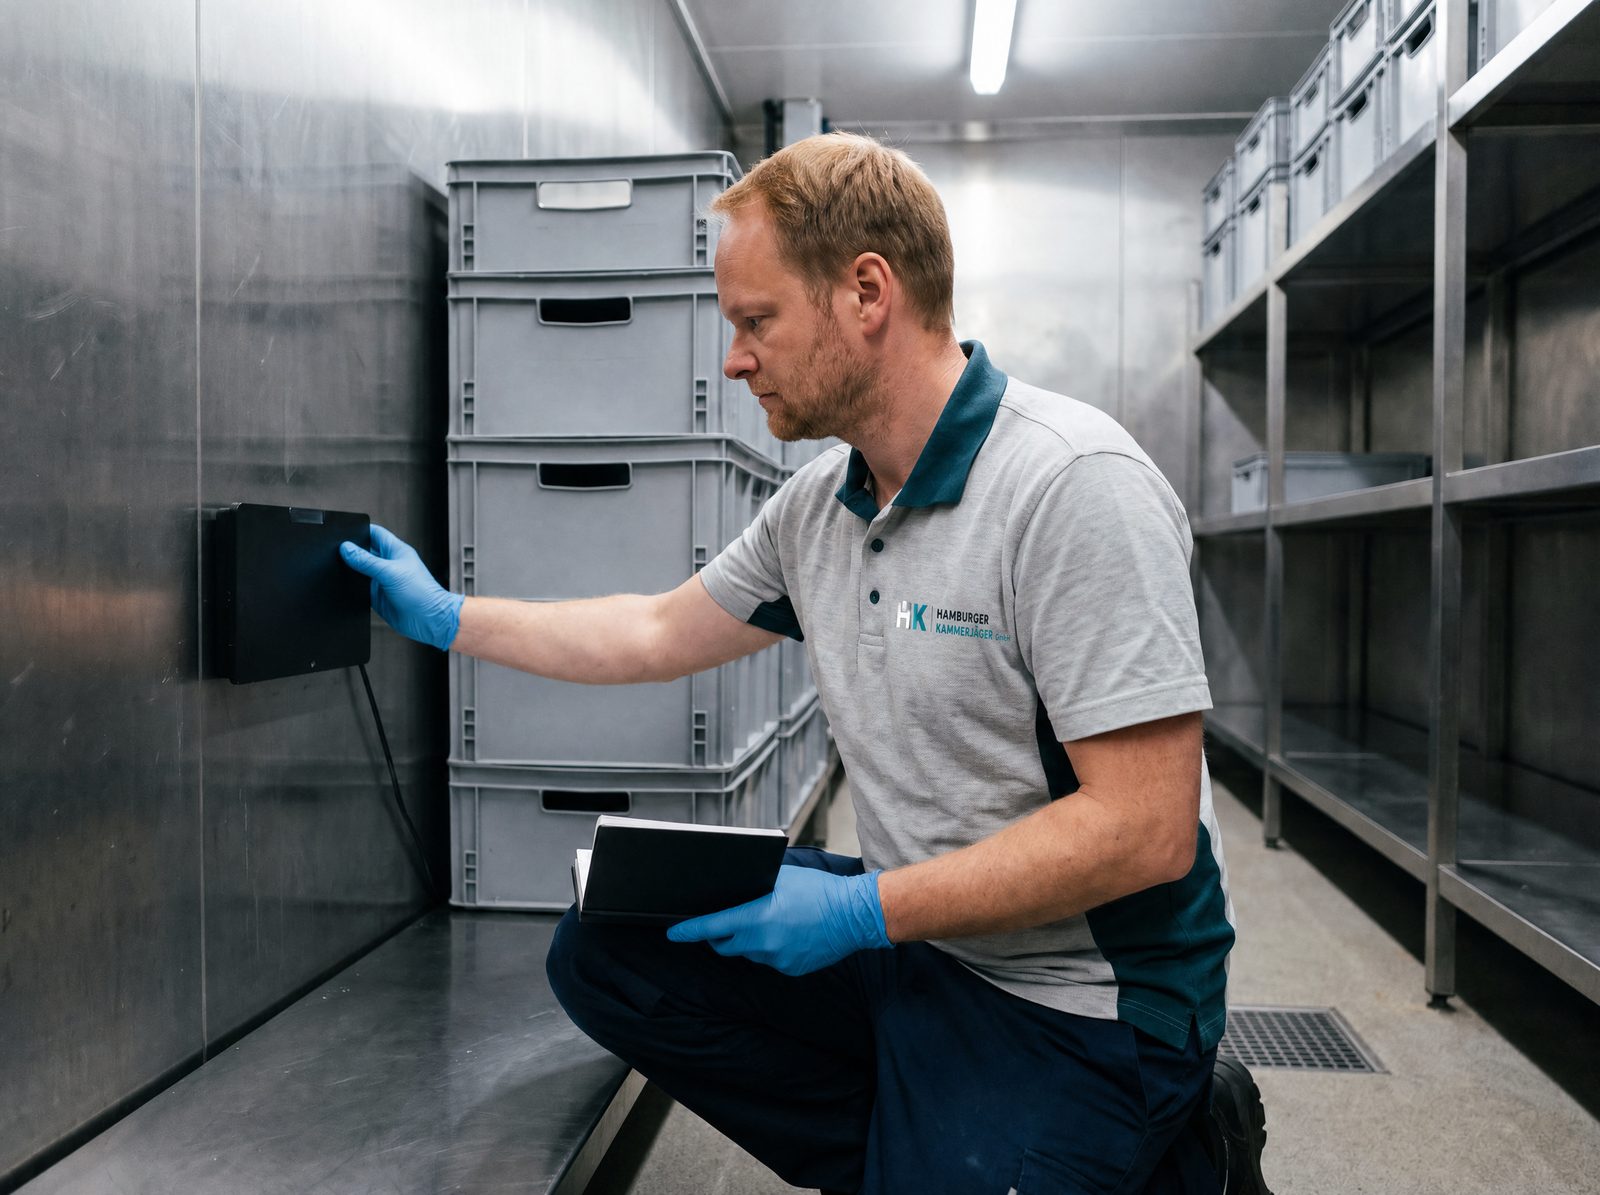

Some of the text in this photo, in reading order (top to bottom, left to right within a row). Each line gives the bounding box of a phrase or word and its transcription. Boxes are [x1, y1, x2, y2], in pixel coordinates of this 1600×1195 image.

[896, 600, 928, 631] HK
[936, 608, 989, 625] HAMBURGER
[935, 623, 993, 640] KAMMERJÄGER
